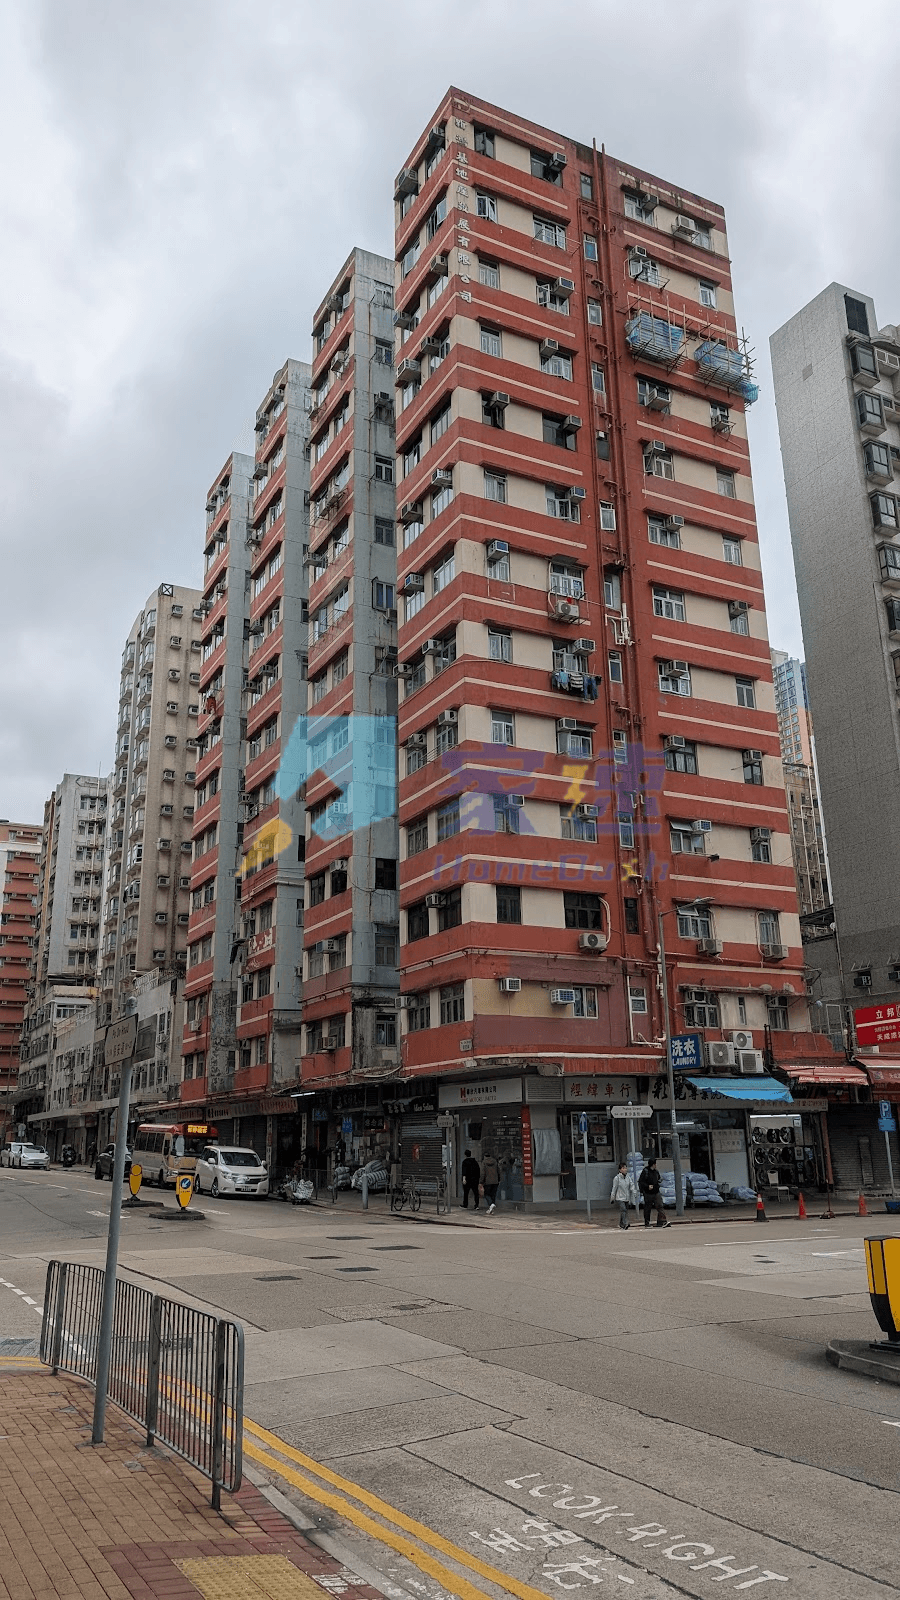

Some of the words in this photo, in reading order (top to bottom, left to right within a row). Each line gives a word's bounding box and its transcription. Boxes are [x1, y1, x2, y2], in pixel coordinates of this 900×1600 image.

[671, 1037, 696, 1057] 洗衣
[672, 1056, 697, 1067] LAUNDRY
[570, 1082, 632, 1098] 經緯車行
[881, 1102, 889, 1117] P
[504, 1473, 634, 1525] LOOK
[626, 1522, 790, 1590] RIGHT
